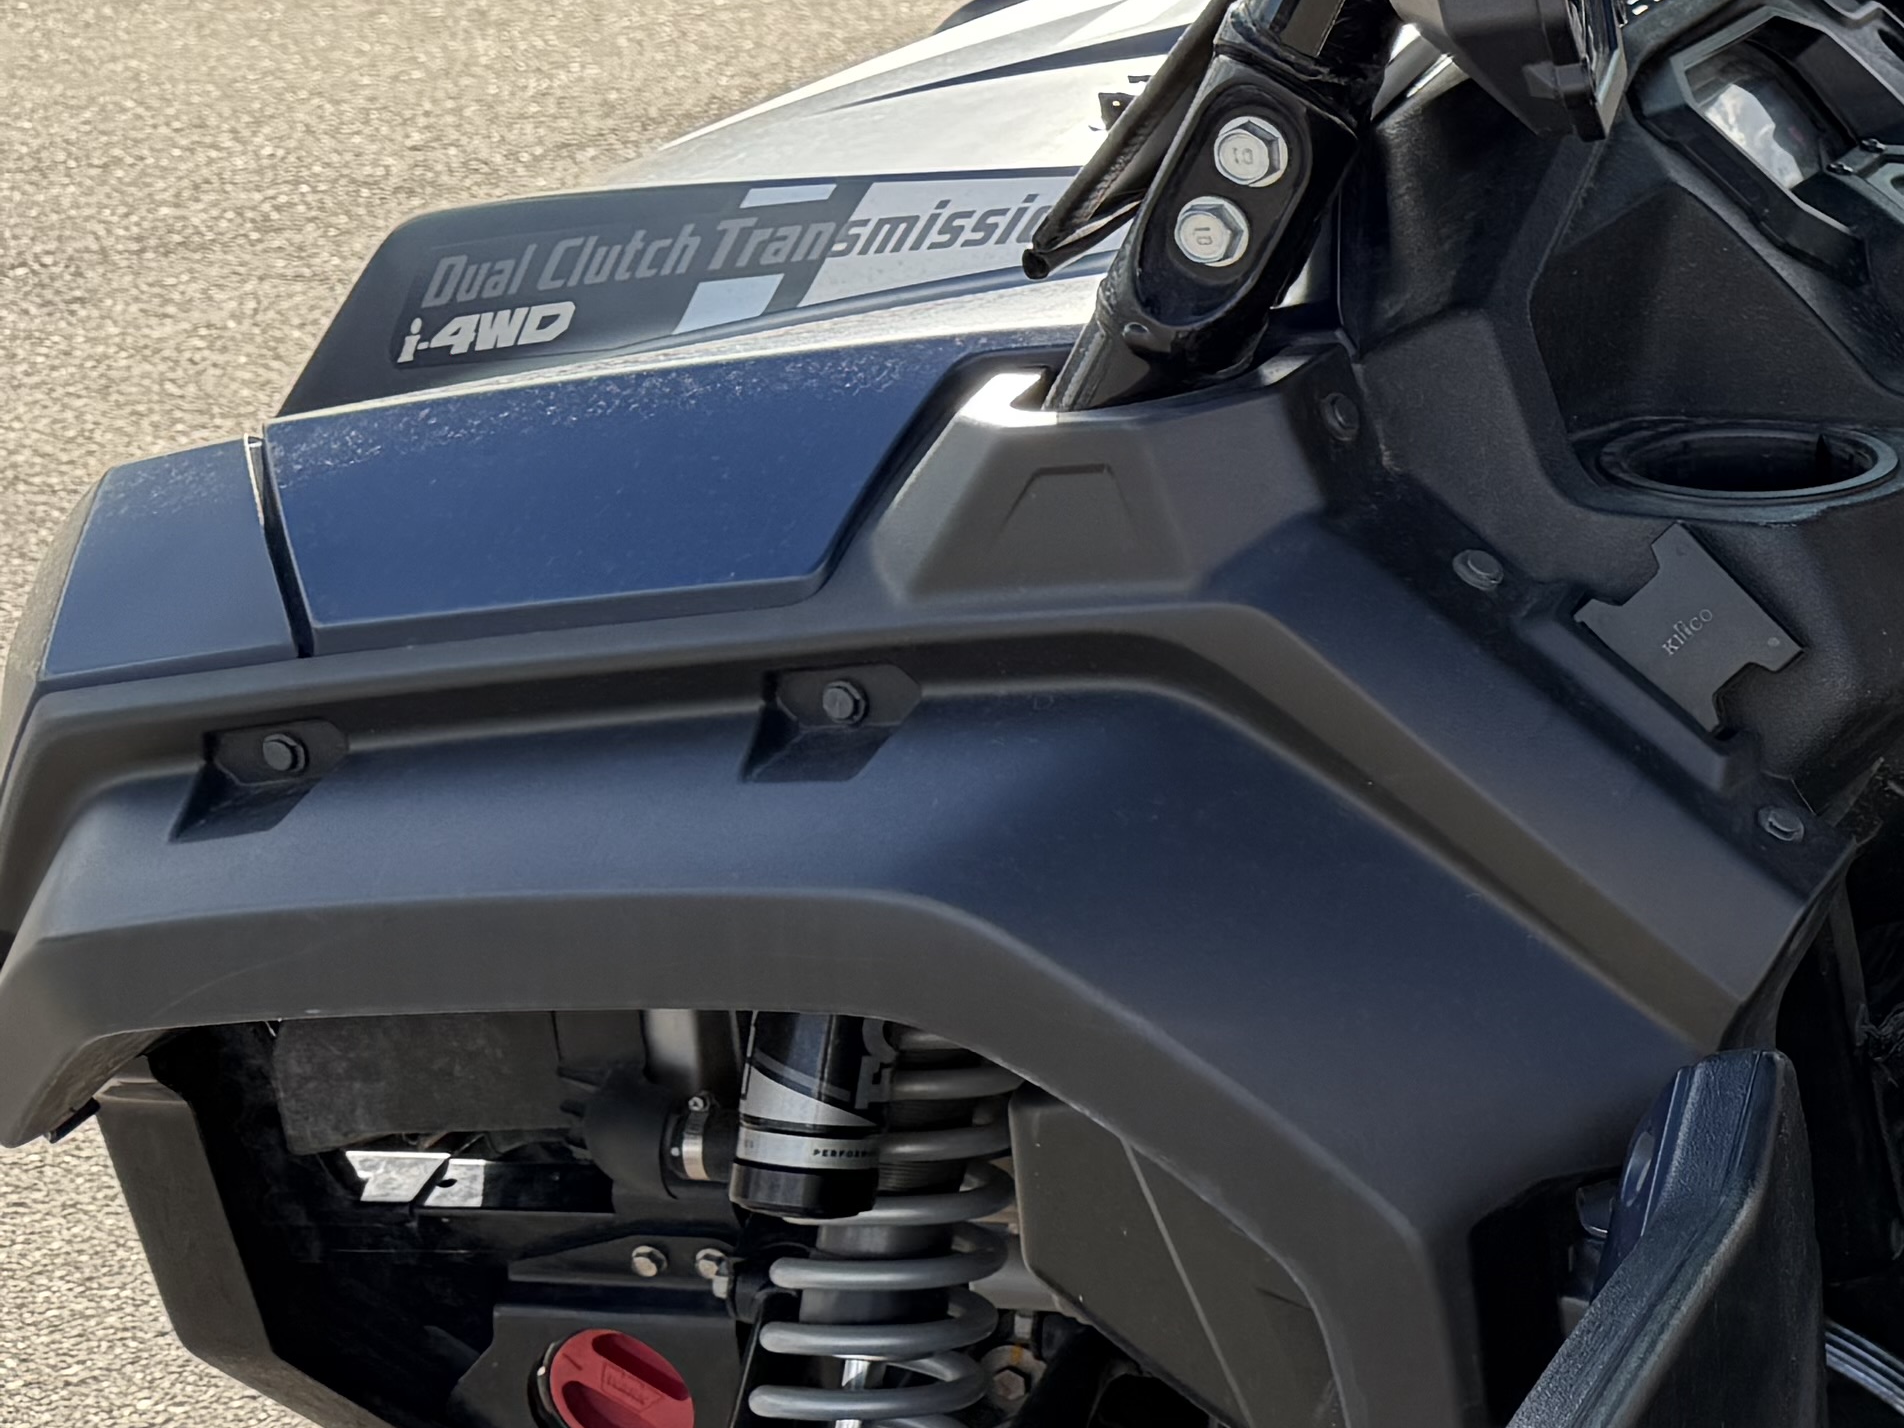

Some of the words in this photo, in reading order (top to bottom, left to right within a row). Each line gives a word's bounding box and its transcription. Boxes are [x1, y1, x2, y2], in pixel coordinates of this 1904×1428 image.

[423, 243, 537, 309] Dual
[538, 226, 700, 292] Clutch
[398, 300, 576, 364] i-4WD
